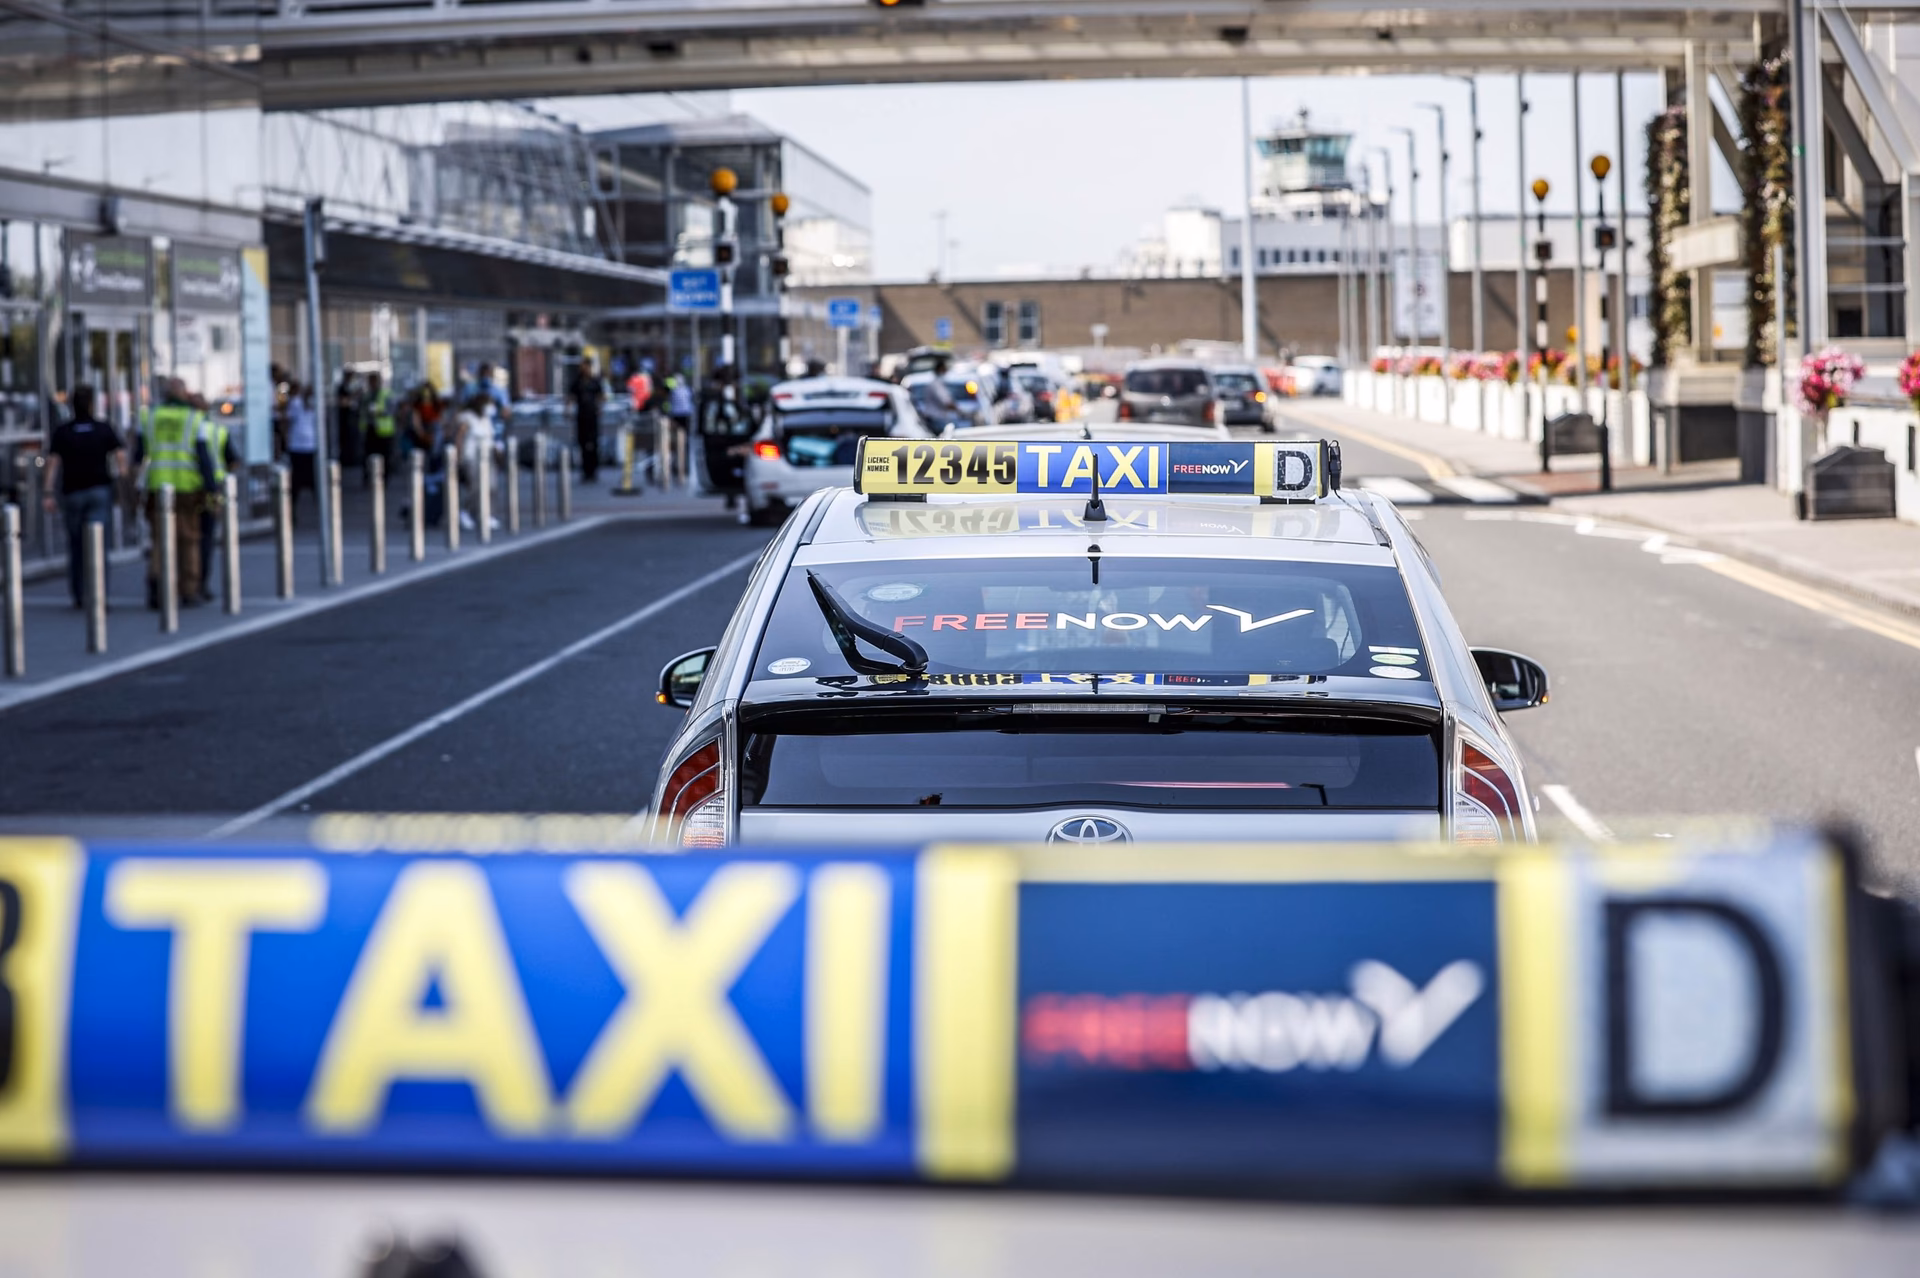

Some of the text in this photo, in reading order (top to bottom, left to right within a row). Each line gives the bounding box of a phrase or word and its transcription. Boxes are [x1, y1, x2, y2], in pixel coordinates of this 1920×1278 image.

[867, 456, 890, 464] LICENCE
[891, 445, 1017, 485] 12345
[1025, 445, 1159, 489] TAXI
[1173, 464, 1231, 475] FREENOW
[1277, 450, 1313, 491] D
[893, 612, 1213, 632] FREENOW
[102, 857, 892, 1144] TAXI
[1603, 896, 1792, 1119] D
